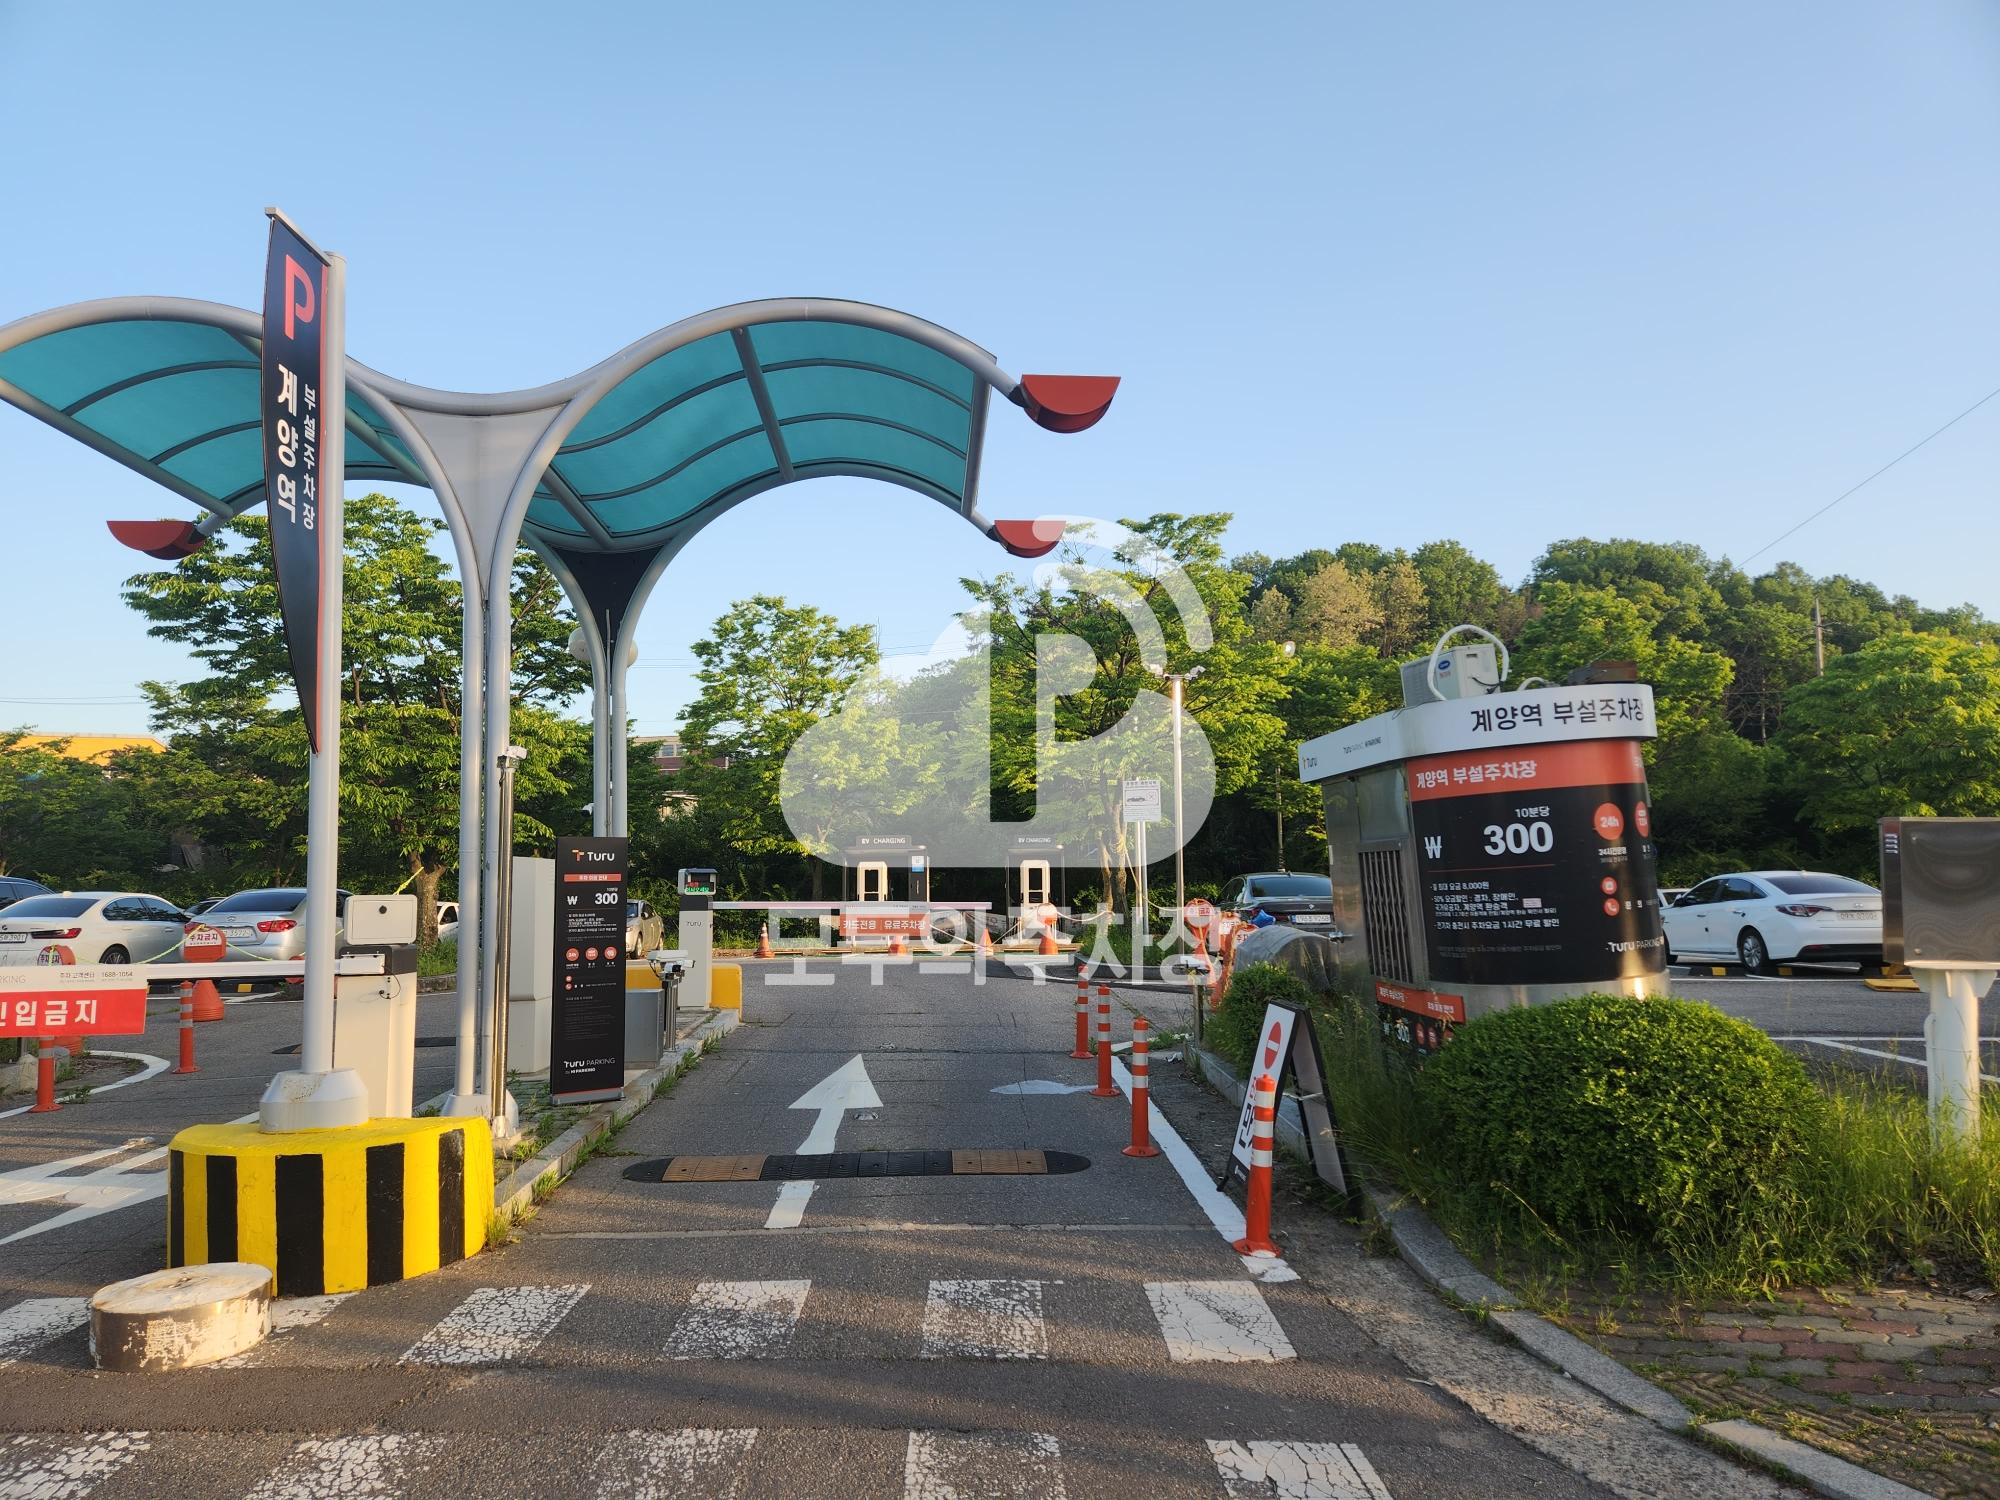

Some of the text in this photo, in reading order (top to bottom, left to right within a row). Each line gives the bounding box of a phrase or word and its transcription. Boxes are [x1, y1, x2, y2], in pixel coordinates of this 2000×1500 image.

[284, 254, 315, 340] P
[277, 364, 298, 524] 계양역
[303, 384, 316, 530] 부설주차장
[1471, 697, 1645, 732] 계양역 부설주차장
[1416, 760, 1537, 789] 계양역 부설주차장
[1515, 806, 1550, 818] 10분당
[1483, 821, 1554, 856] 300
[1449, 882, 1461, 891] 요금
[594, 892, 618, 905] 300
[1463, 903, 1484, 911] 계양역
[843, 919, 927, 930] 카드전용 유료주차장
[1471, 921, 1501, 930] 주차요금
[1502, 920, 1523, 929] 1시간
[1525, 919, 1541, 928] 무료
[1543, 918, 1560, 928] 할인
[586, 1057, 616, 1066] PARKING
